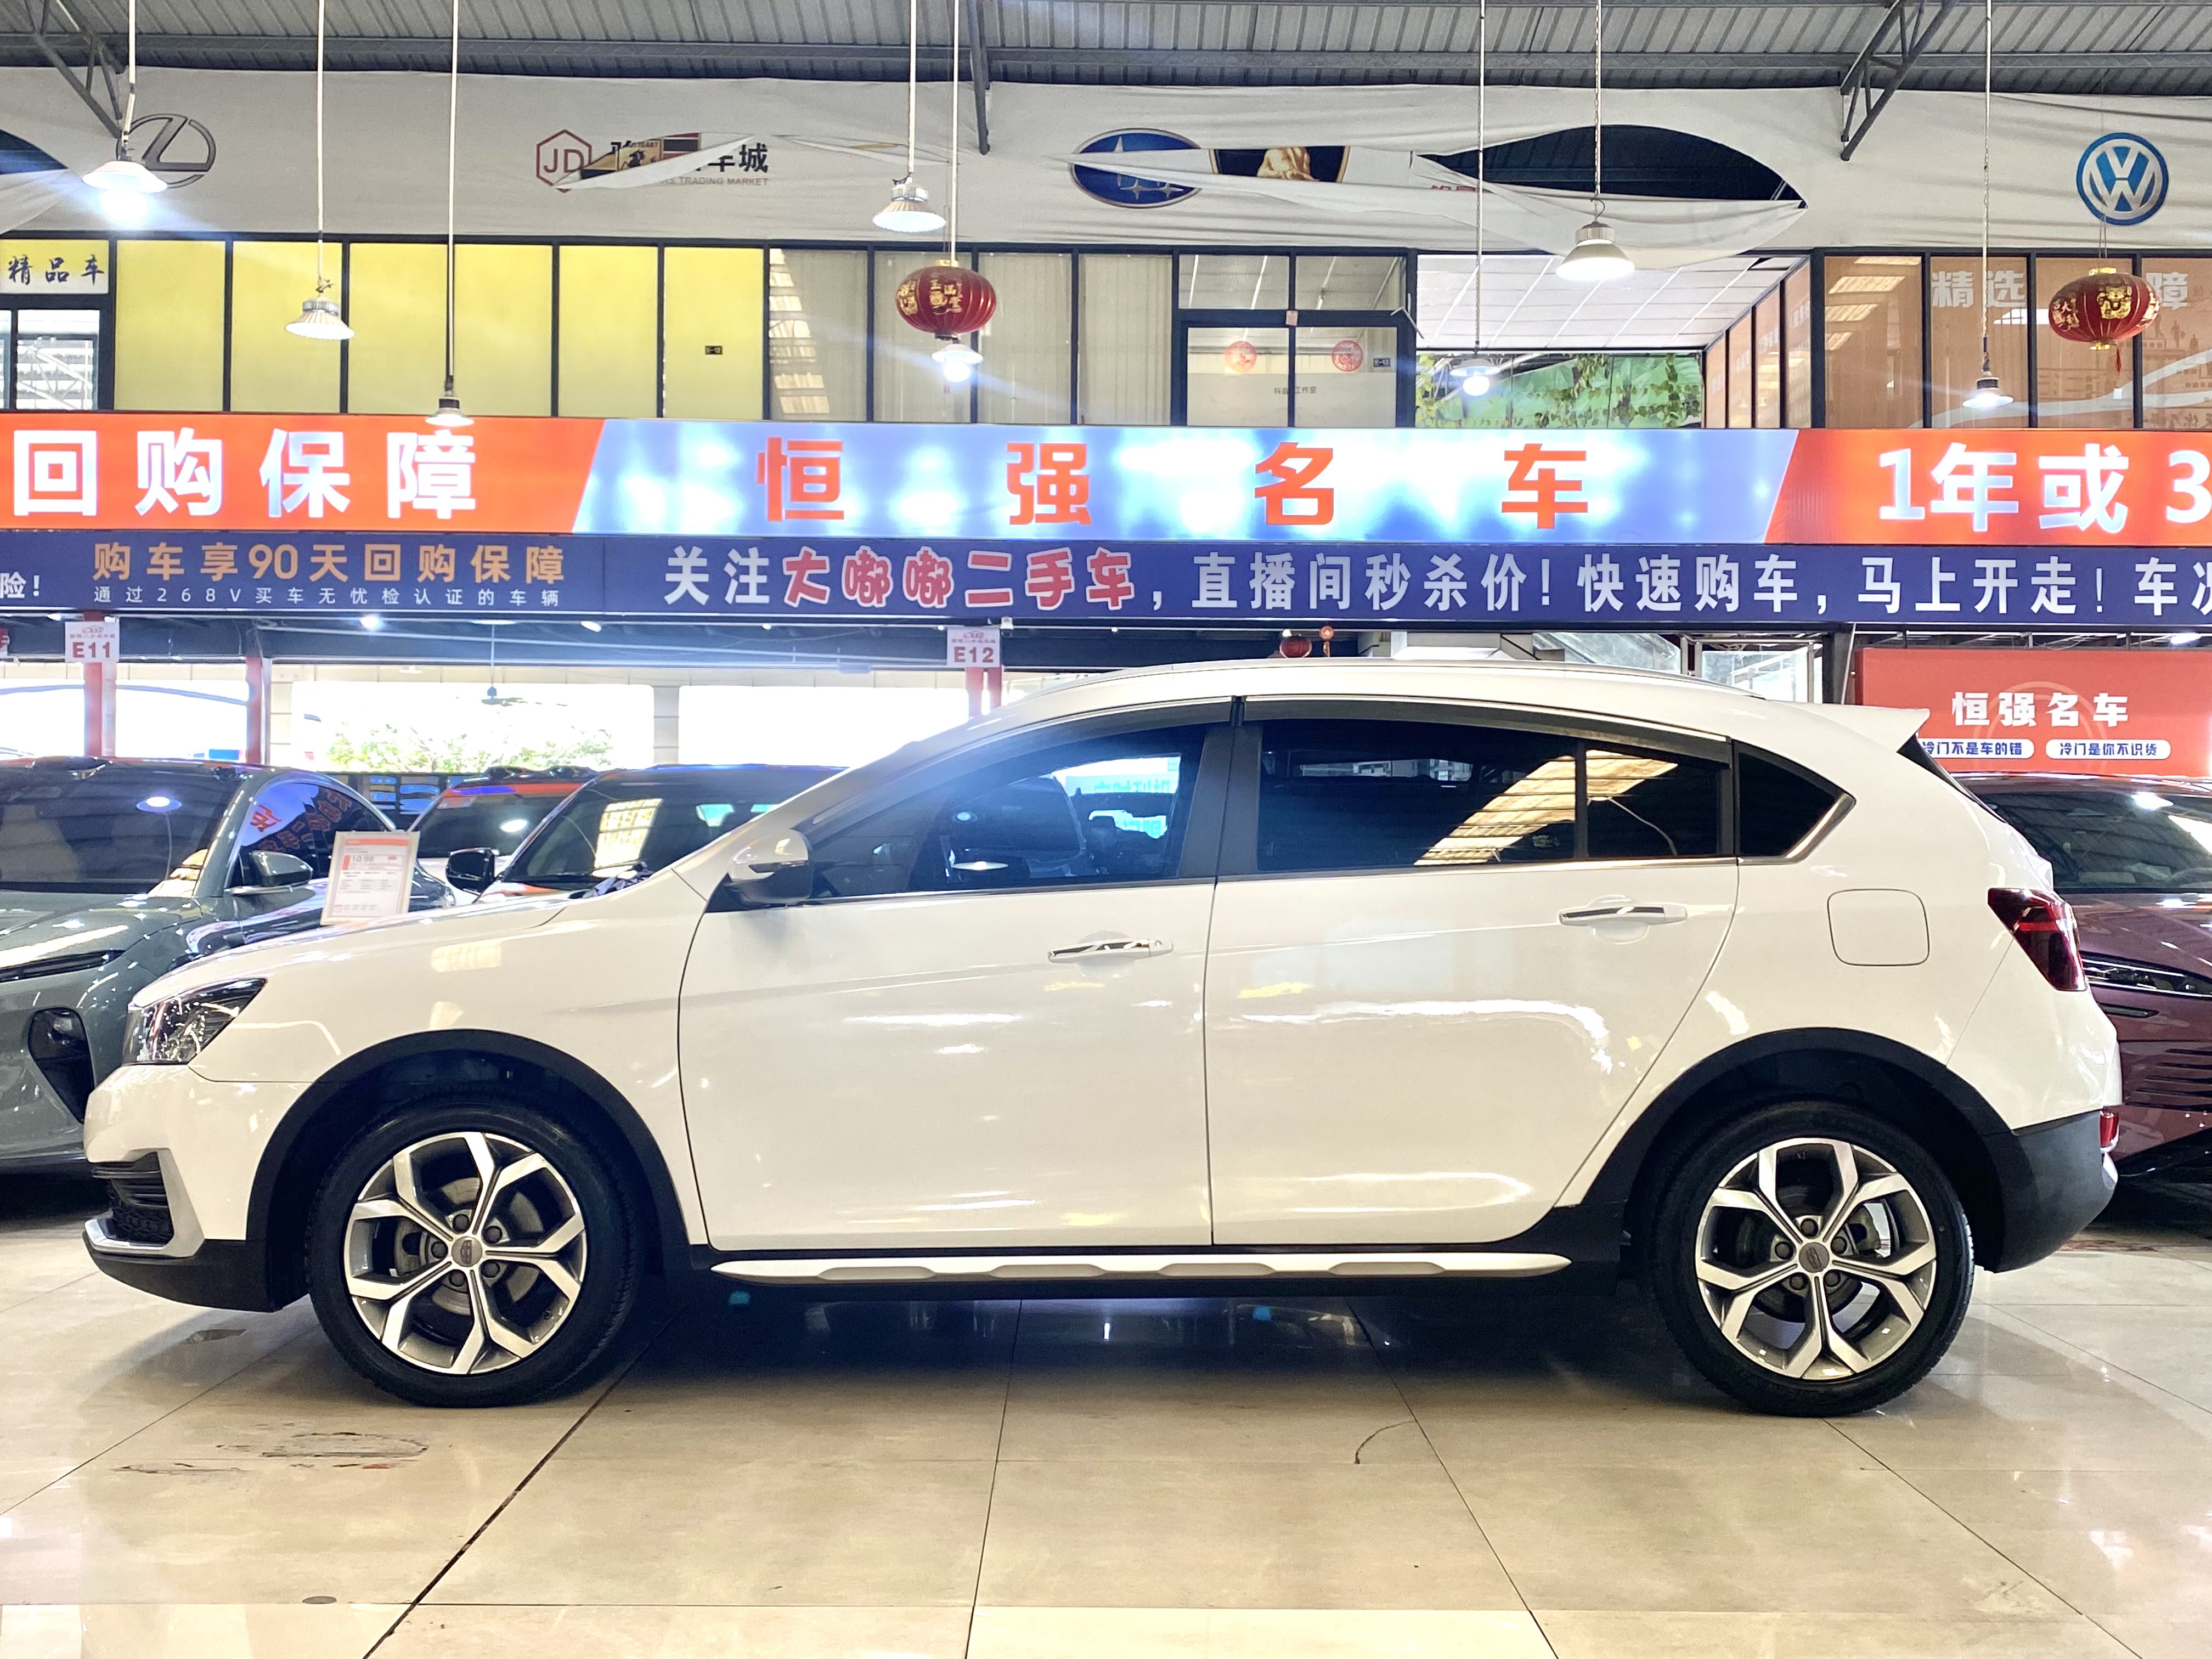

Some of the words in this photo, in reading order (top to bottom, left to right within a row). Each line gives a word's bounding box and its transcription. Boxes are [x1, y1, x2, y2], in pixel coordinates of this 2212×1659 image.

[679, 177, 724, 185] TRADING
[727, 178, 768, 186] MARKET
[8, 254, 105, 286] 精品车
[14, 427, 476, 520] 回购保障
[755, 437, 1589, 529] 恒强名车
[92, 541, 565, 584] 购车享90天回购保障
[94, 586, 560, 606] 通过268V买车无忧检认证的车辆
[72, 641, 110, 658] E11
[954, 646, 994, 663] E12
[1952, 691, 2129, 727] 恒强名车
[1922, 741, 2022, 755] 冷门不是车的错
[2059, 742, 2157, 756] 冷门是你不识货
